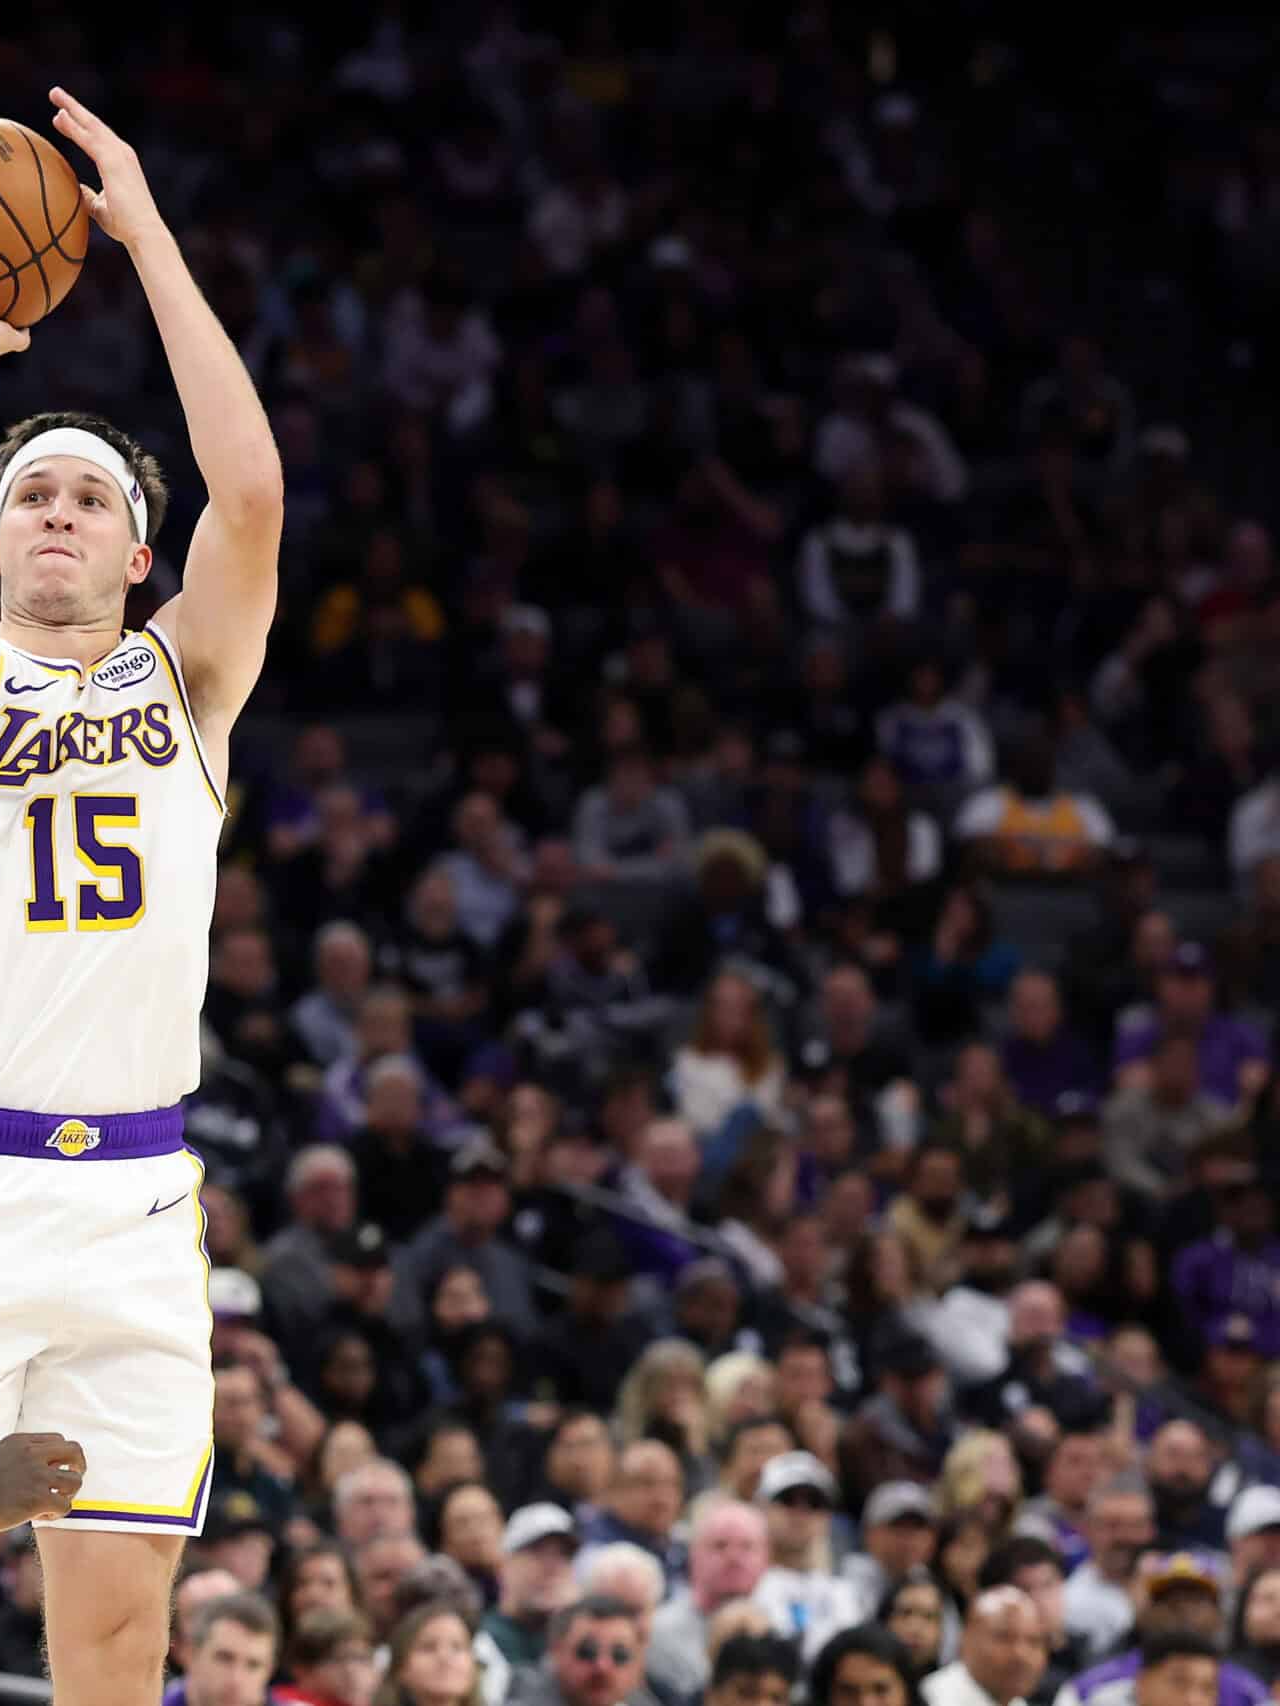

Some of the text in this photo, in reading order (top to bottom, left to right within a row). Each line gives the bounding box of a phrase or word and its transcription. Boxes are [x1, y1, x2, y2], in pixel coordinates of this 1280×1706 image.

[97, 652, 151, 682] bibigo
[23, 792, 147, 932] 15
[48, 1126, 99, 1149] LAKERS
